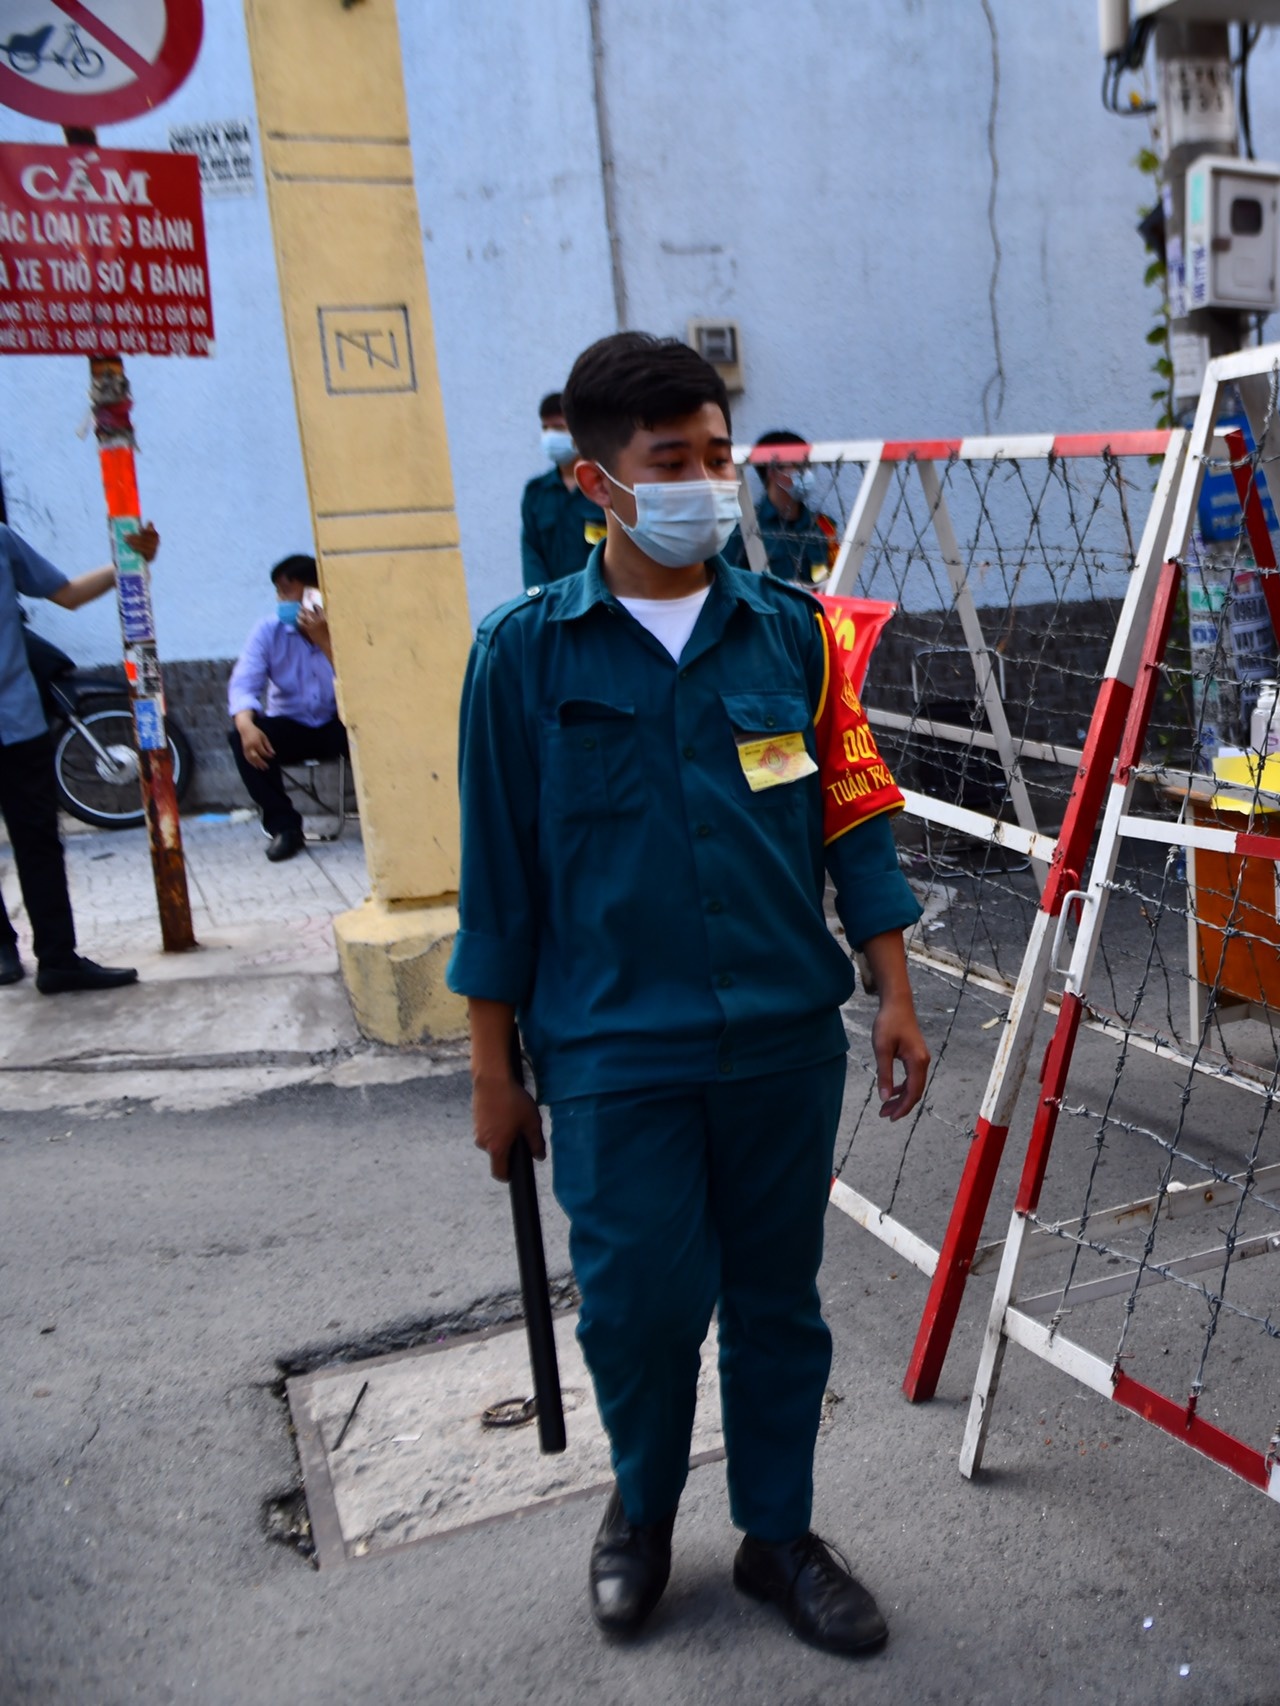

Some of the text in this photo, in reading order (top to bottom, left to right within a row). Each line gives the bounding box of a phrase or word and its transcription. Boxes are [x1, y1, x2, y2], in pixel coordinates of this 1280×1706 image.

[21, 152, 153, 207] CẤM
[31, 211, 81, 250] LOẠI
[85, 213, 114, 247] XE
[118, 213, 134, 248] 3
[137, 209, 195, 252] BÁNH
[14, 257, 44, 291] XE
[130, 261, 144, 295] 4
[148, 255, 206, 298] BÁNH
